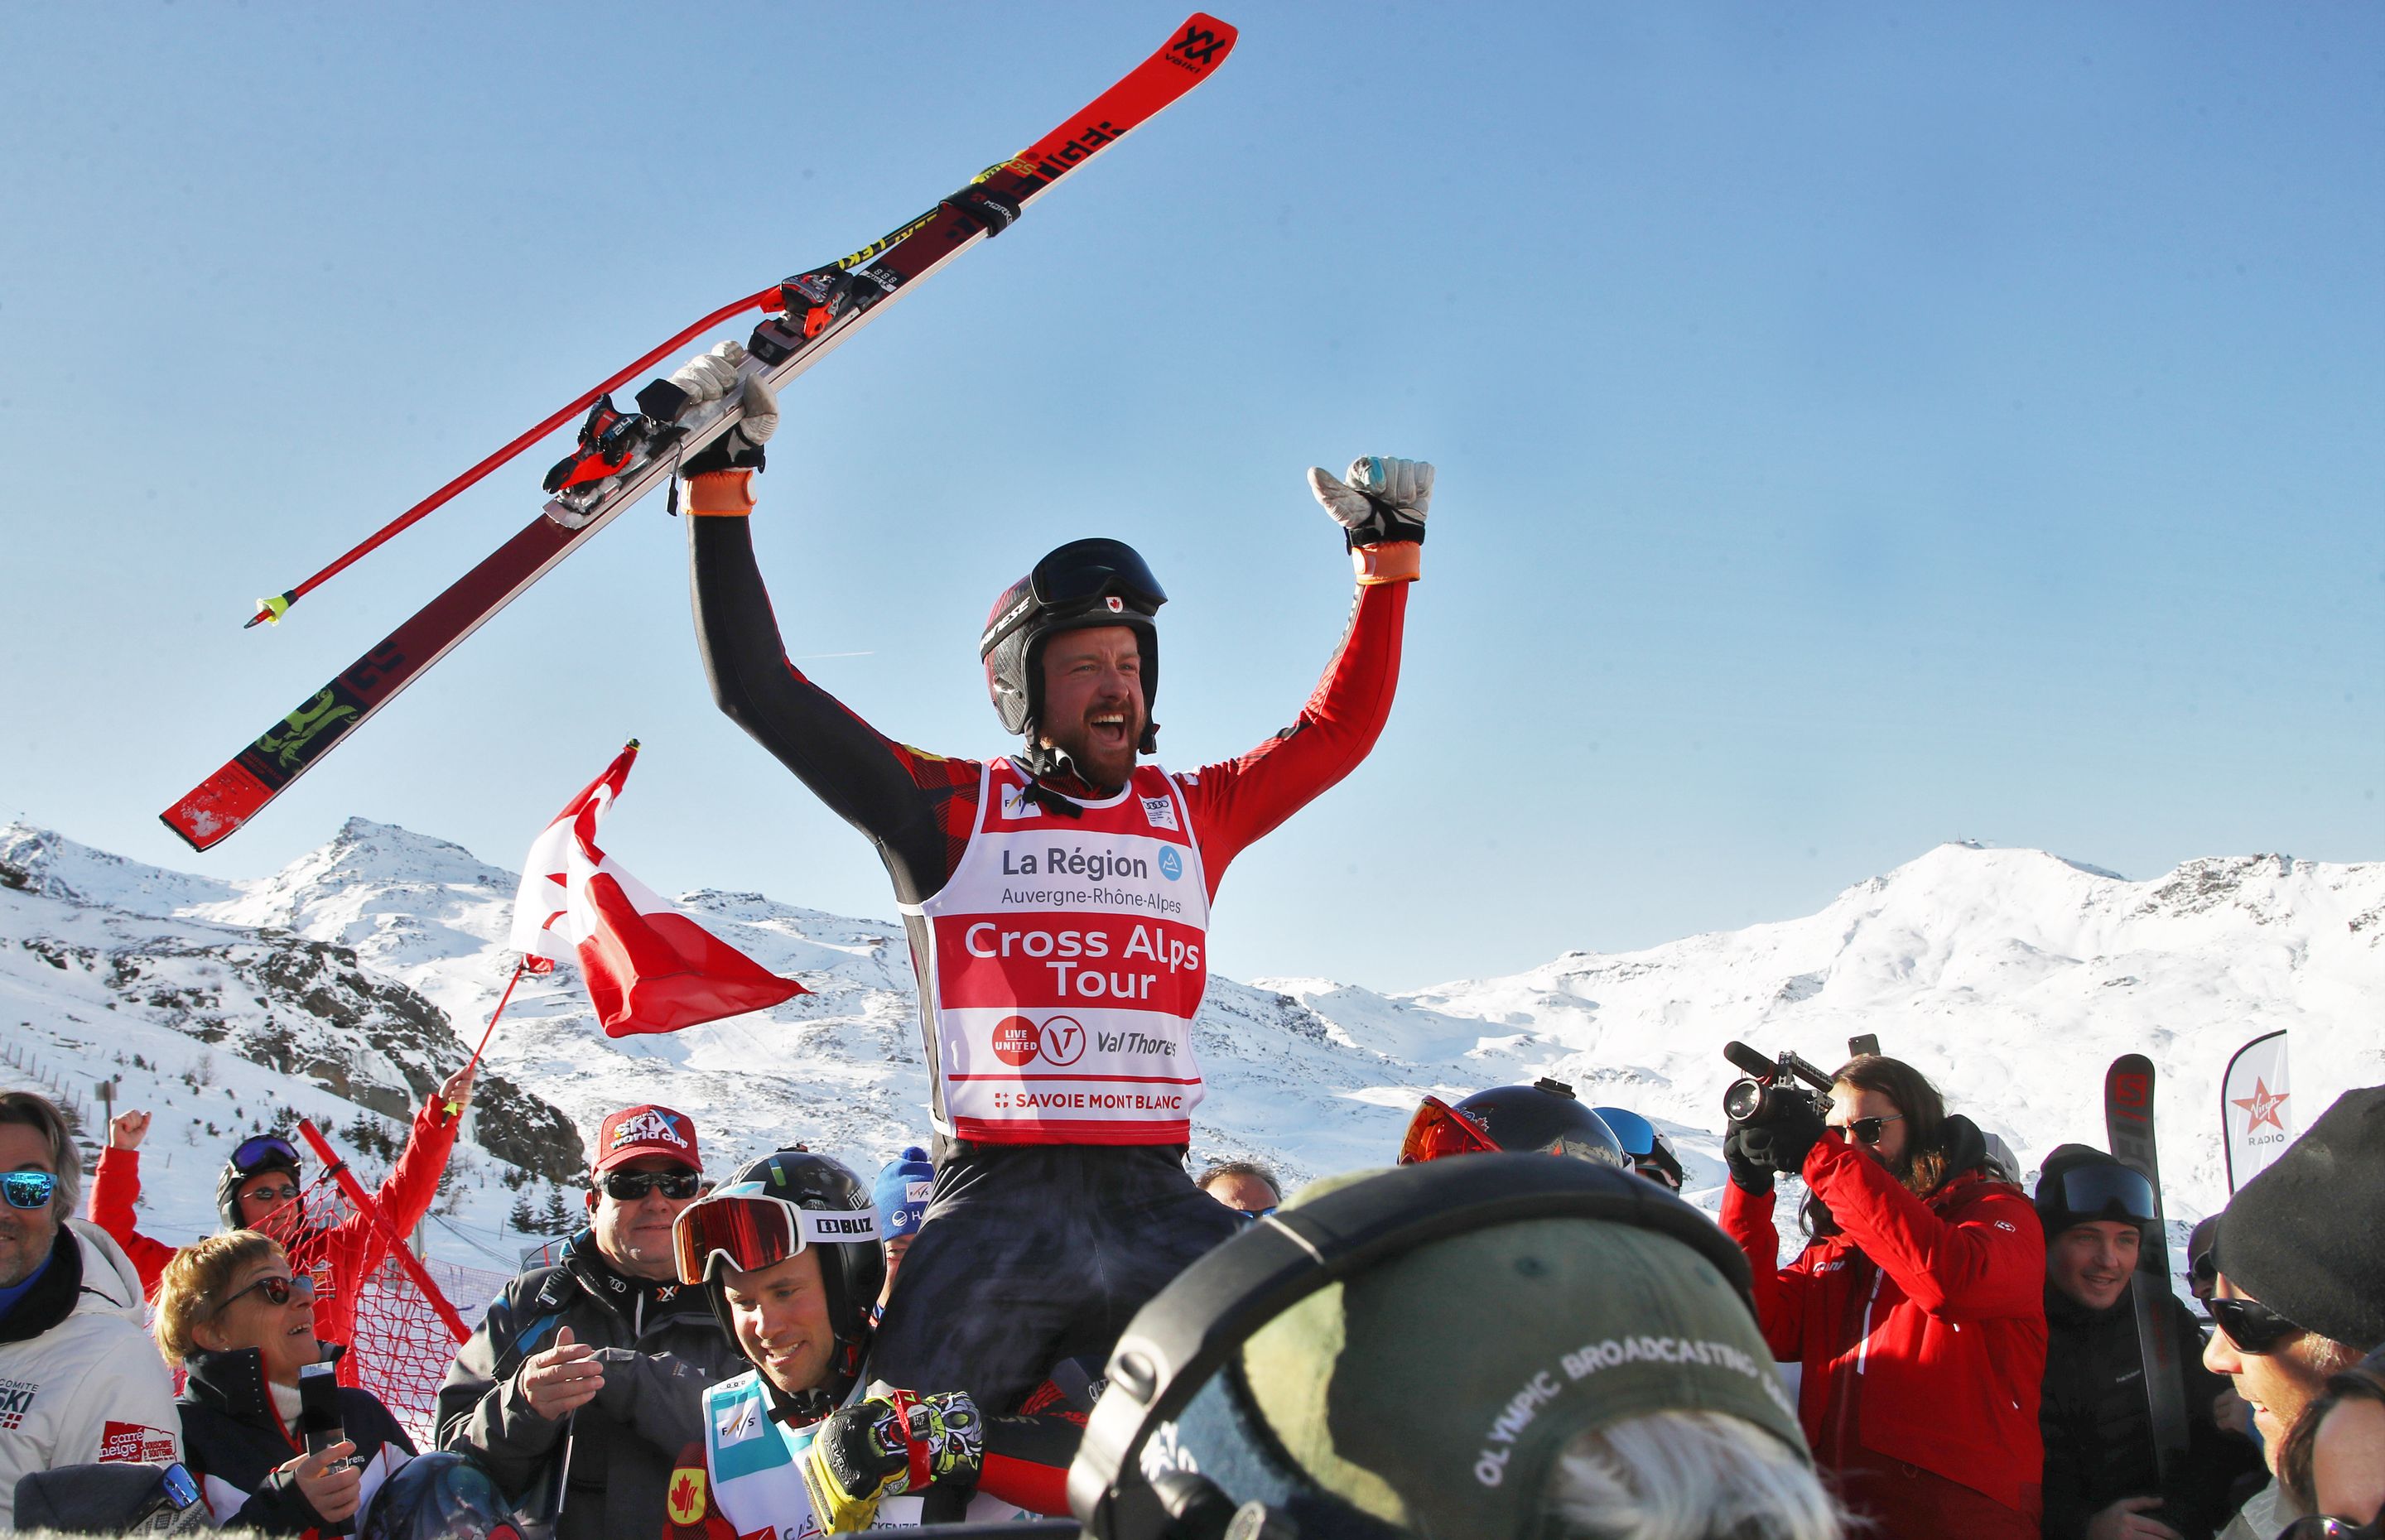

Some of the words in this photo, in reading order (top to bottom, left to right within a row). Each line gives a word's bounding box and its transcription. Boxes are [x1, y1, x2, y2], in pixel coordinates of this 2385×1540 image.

[1007, 157, 1037, 176] GS
[837, 238, 887, 271] LEKI
[1002, 849, 1038, 875] La
[1047, 846, 1148, 882] Région
[1001, 888, 1182, 914] Auvergne-Rhône-Alpes
[965, 922, 1109, 959] Cross
[1122, 924, 1200, 974] Alps
[1046, 960, 1158, 1000] Tour
[1005, 1029, 1028, 1039] LIVE
[1097, 1031, 1126, 1053] Val
[995, 1041, 1038, 1052] UNITED
[1015, 1093, 1085, 1109] SAVOIE
[1089, 1094, 1133, 1109] MONT
[1135, 1095, 1183, 1109] BLANC
[610, 1130, 659, 1149] world
[661, 1132, 689, 1149] cup
[2248, 1133, 2285, 1146] RADIO
[840, 1216, 874, 1234] BLIZ
[1474, 1369, 1562, 1488] OLYMPIC
[1559, 1335, 1760, 1380] BROADCASTING
[109, 1427, 144, 1445] carré
[99, 1443, 137, 1457] neige
